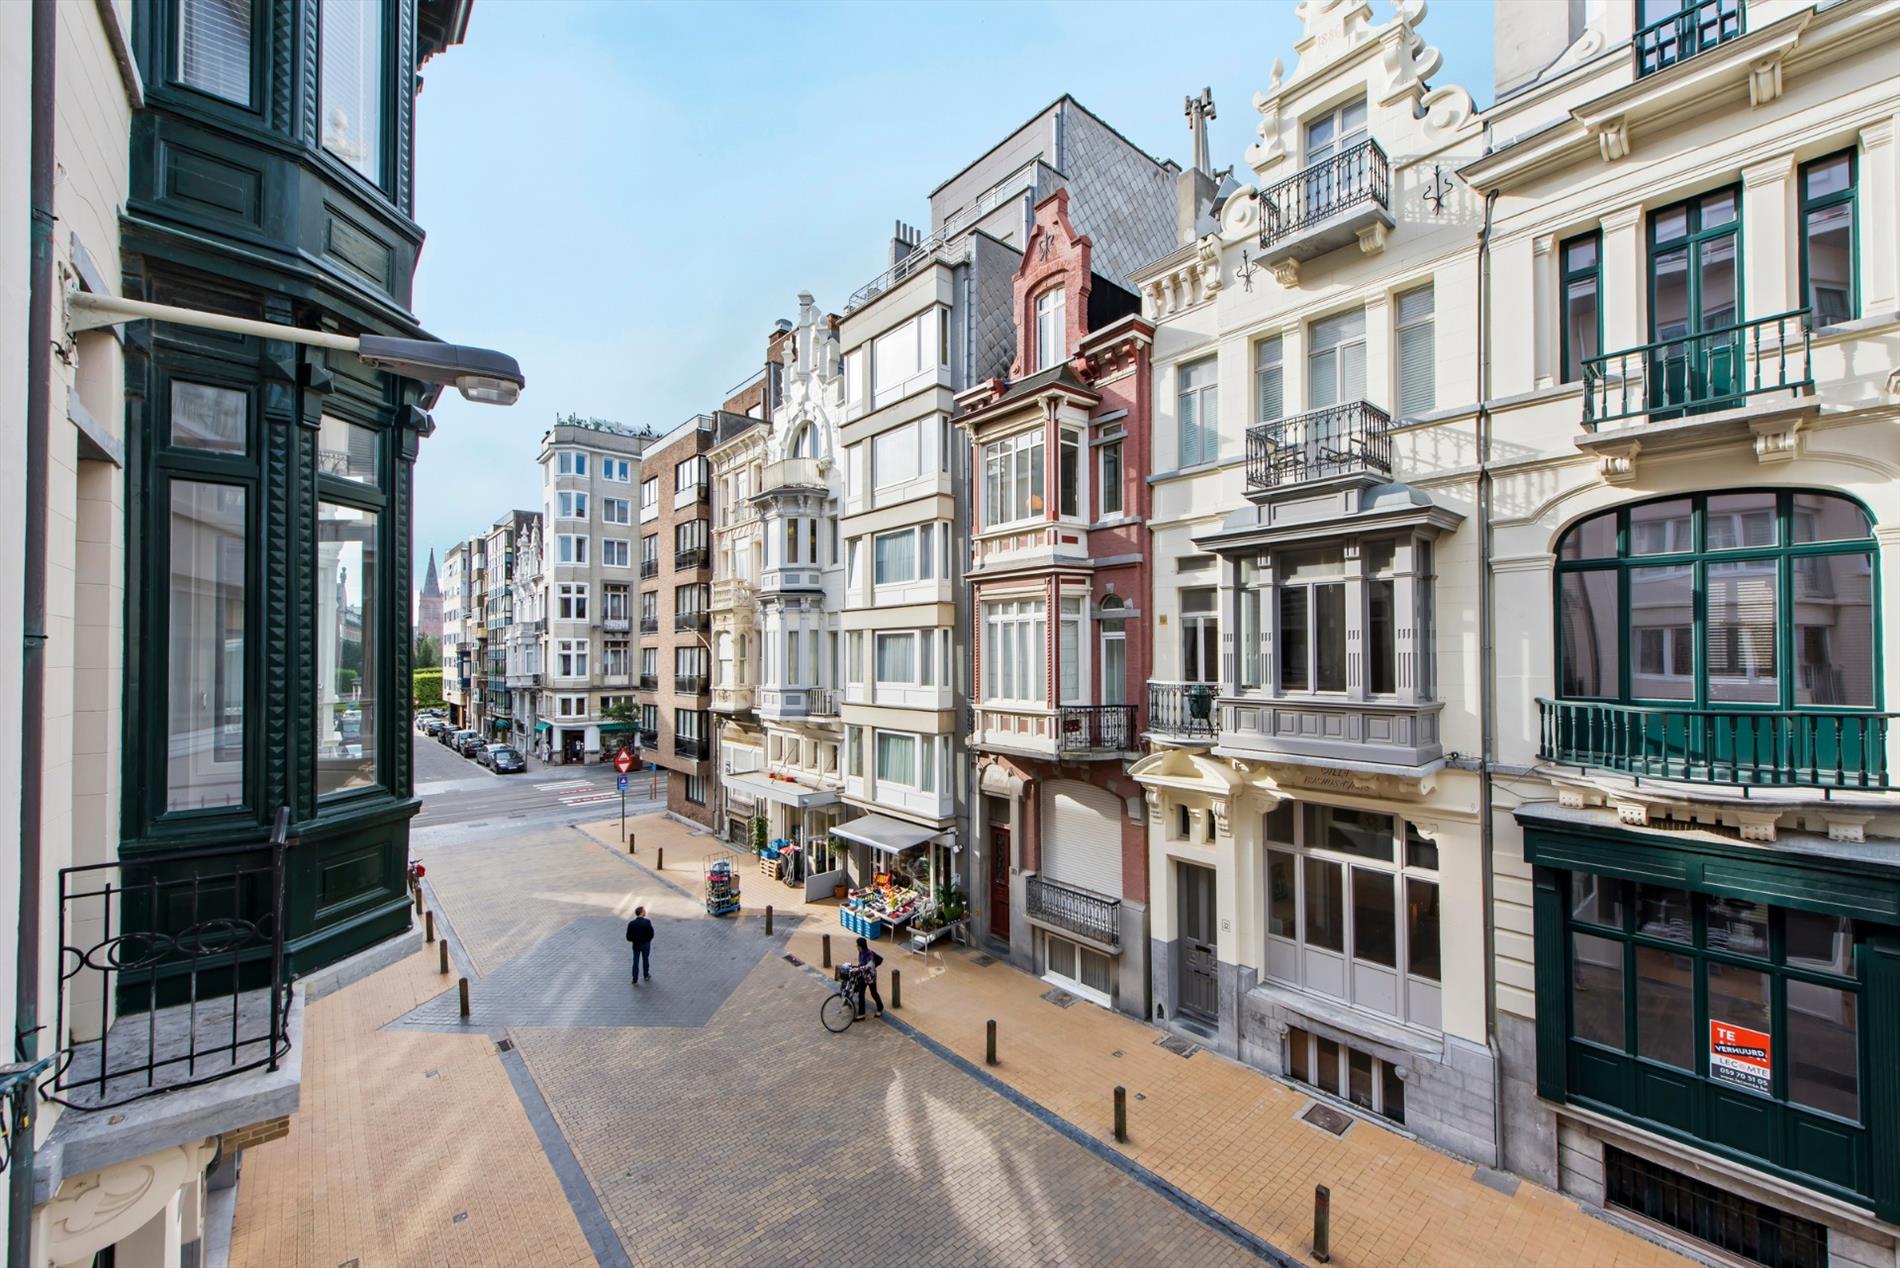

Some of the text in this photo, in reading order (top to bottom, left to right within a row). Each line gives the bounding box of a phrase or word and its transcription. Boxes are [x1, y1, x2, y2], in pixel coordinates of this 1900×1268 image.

[1717, 1027, 1736, 1042] TE
[1715, 1045, 1764, 1057] VERHUURD
[1720, 1067, 1735, 1075] 059
[1736, 1071, 1746, 1079] 70
